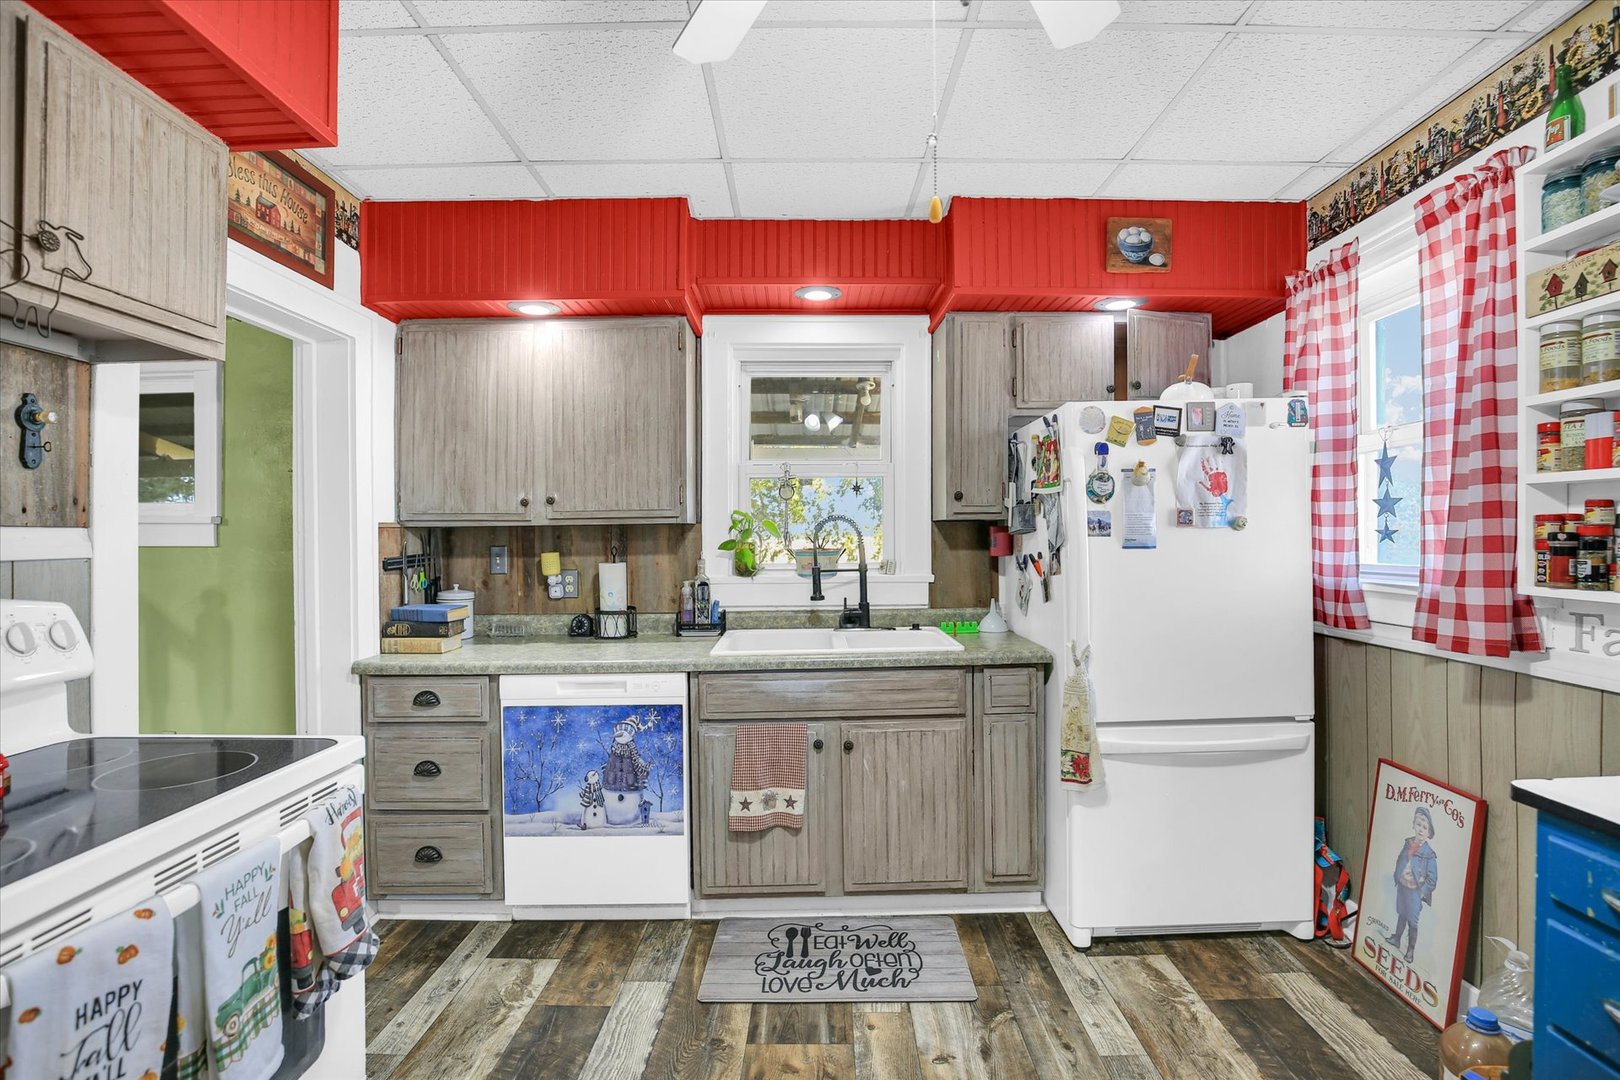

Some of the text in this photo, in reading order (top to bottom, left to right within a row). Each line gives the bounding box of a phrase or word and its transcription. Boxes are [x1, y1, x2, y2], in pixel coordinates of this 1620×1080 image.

[258, 172, 278, 198] this
[280, 188, 309, 225] House
[225, 861, 265, 901] HAPPY
[234, 887, 259, 912] FALL
[847, 931, 911, 950] Well
[756, 950, 850, 979] Laugh
[815, 968, 912, 992] Much
[1363, 936, 1439, 1007] SEEDS
[76, 979, 143, 1031] HAPPY
[60, 1002, 142, 1080] Fall
